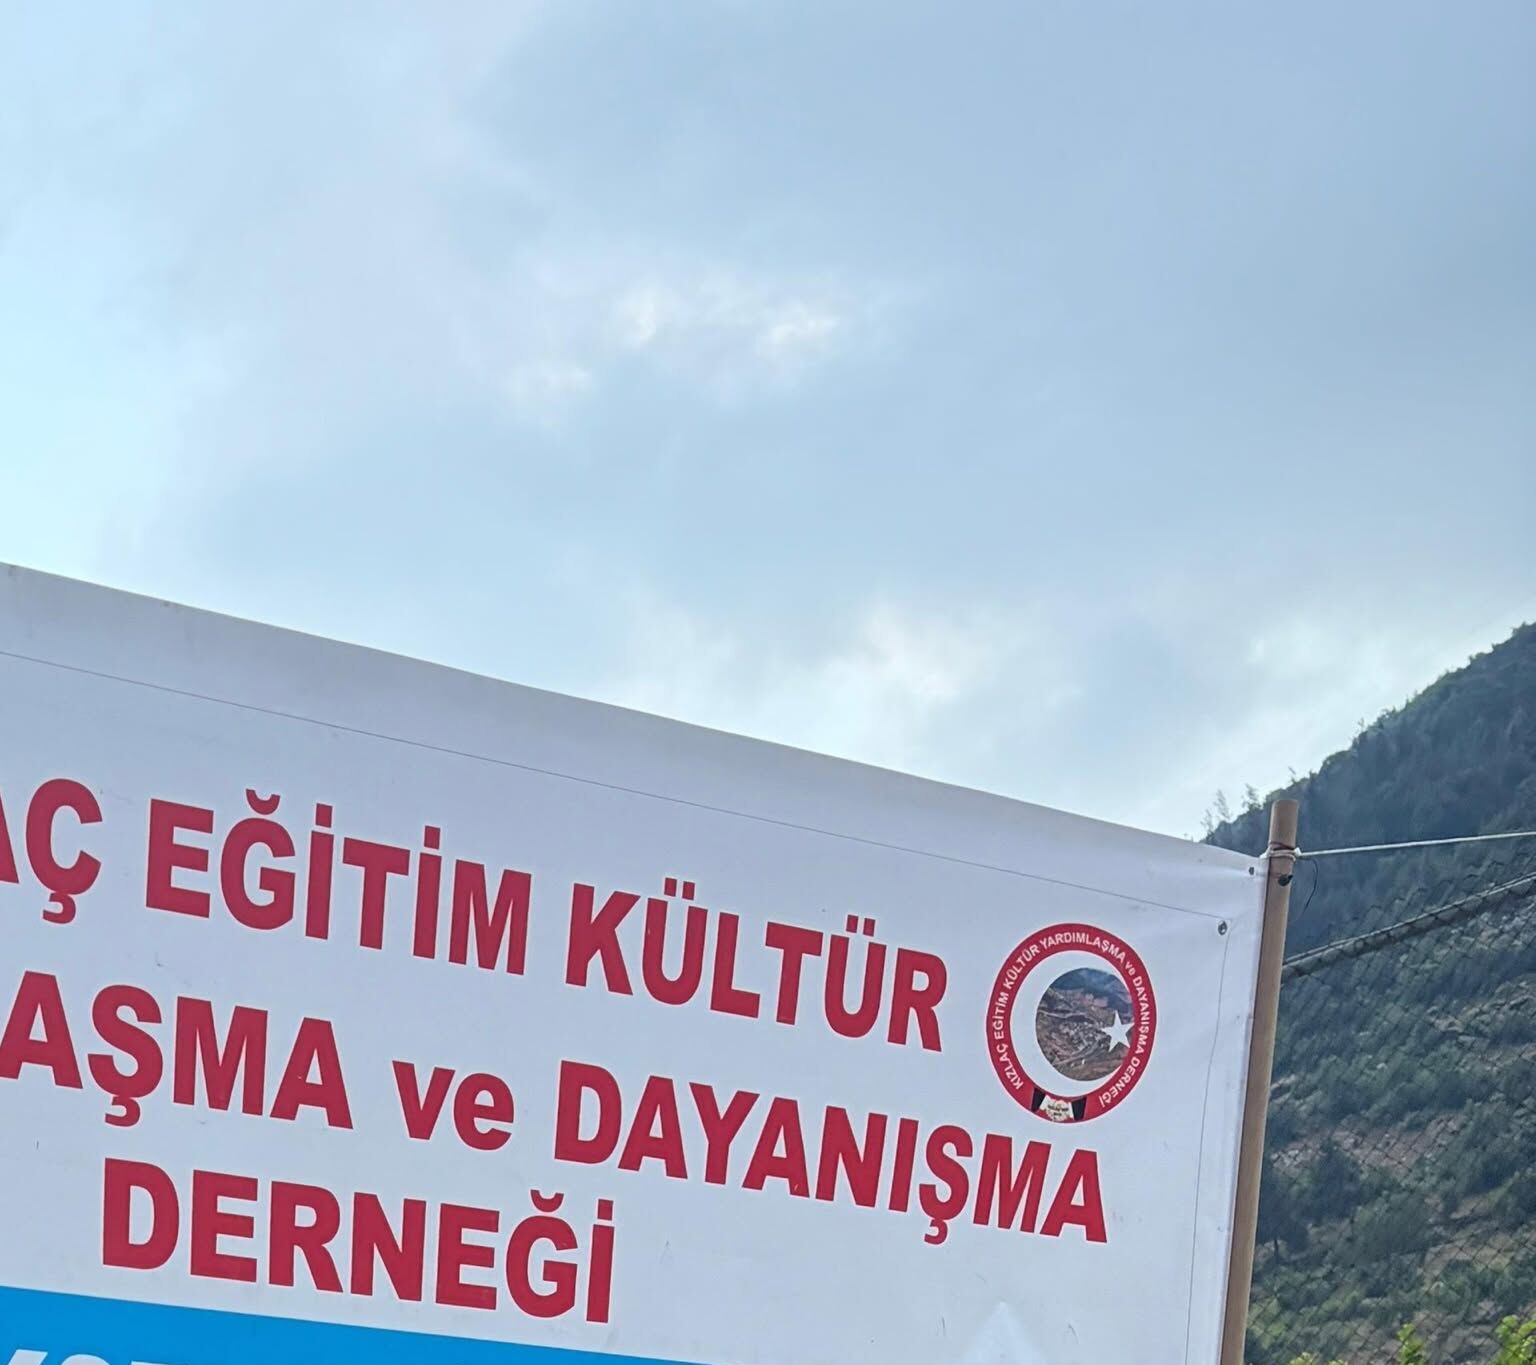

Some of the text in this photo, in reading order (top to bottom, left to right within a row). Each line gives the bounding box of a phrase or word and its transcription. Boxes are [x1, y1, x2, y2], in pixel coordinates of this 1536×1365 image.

[147, 788, 531, 975] EĞİTİM
[566, 878, 947, 1052] KÜLTÜR
[102, 1158, 614, 1324] DERNEĞİ
[393, 1061, 514, 1151] ve
[554, 1061, 1107, 1245] DAYANIŞMA
